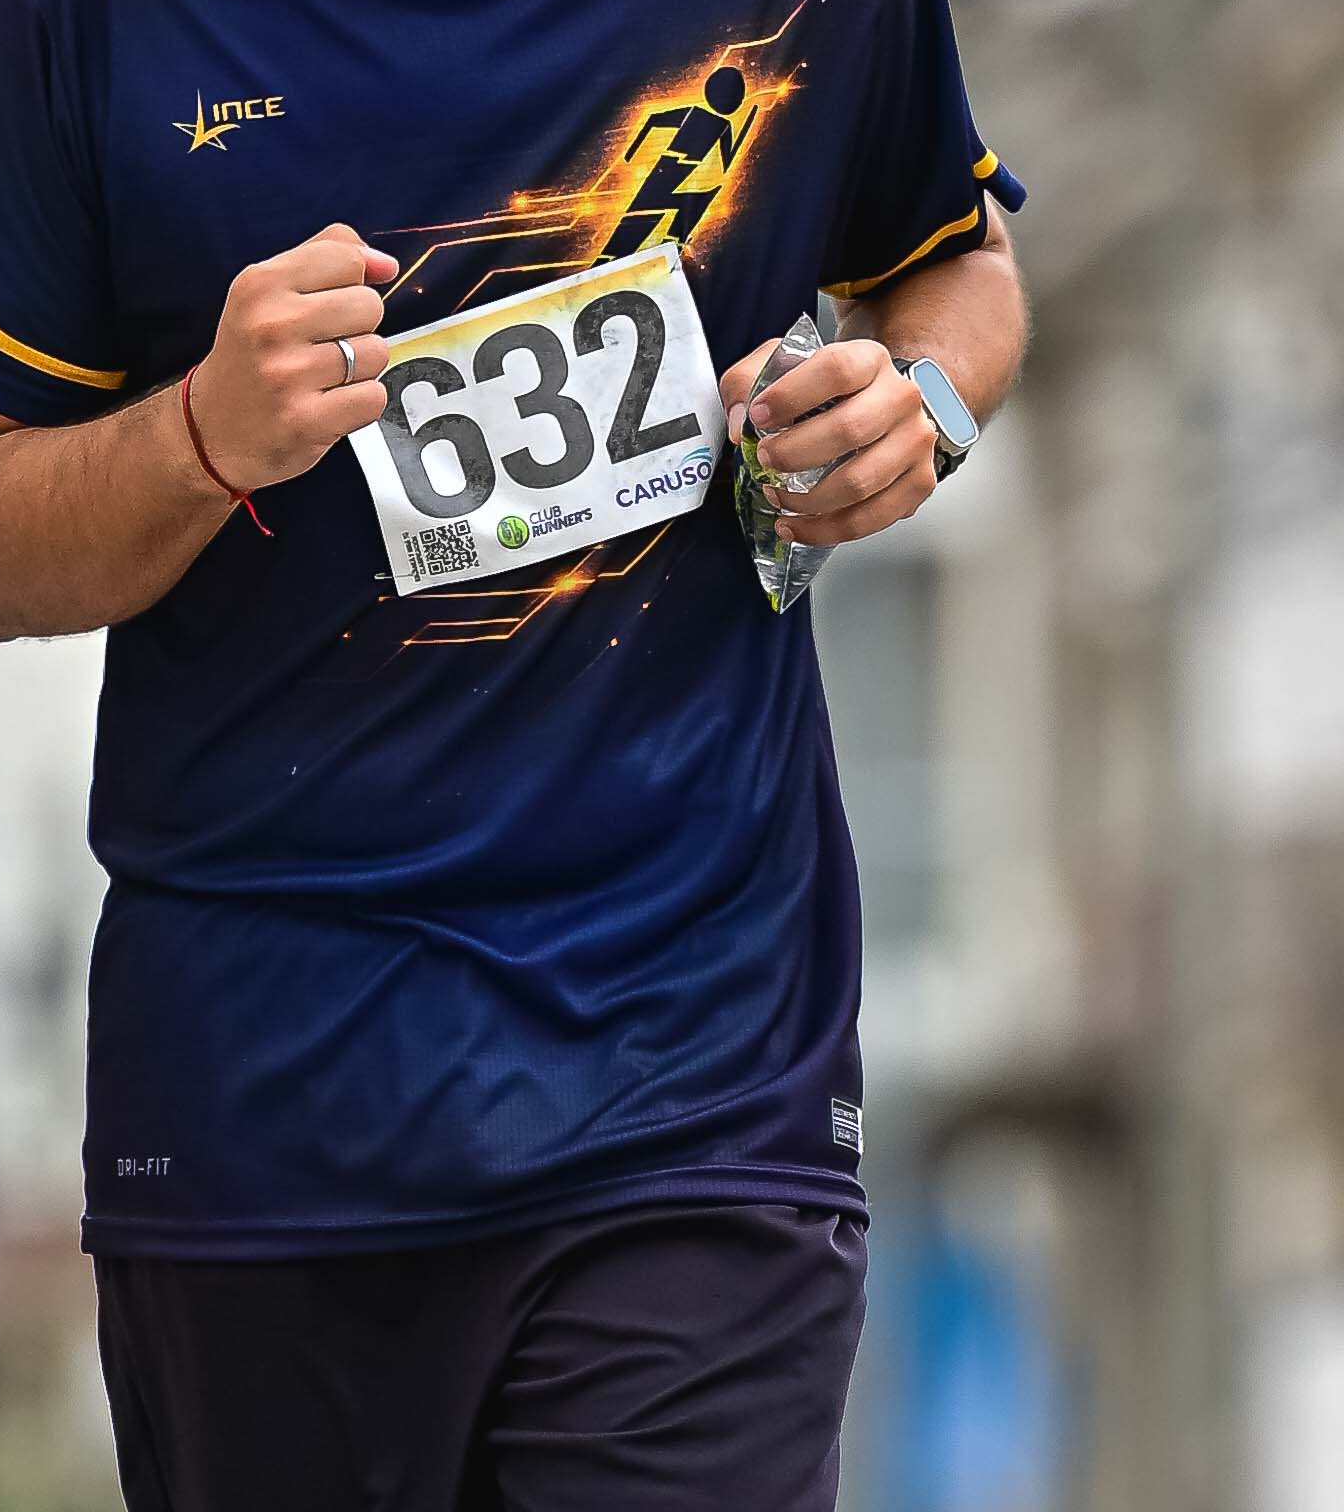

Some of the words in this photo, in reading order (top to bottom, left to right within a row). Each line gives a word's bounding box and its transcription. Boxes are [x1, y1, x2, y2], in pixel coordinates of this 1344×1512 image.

[378, 290, 702, 519] 632
[616, 461, 712, 508] CARUSO
[529, 505, 562, 524] CLUB
[117, 1157, 171, 1177] DRI-FIT
